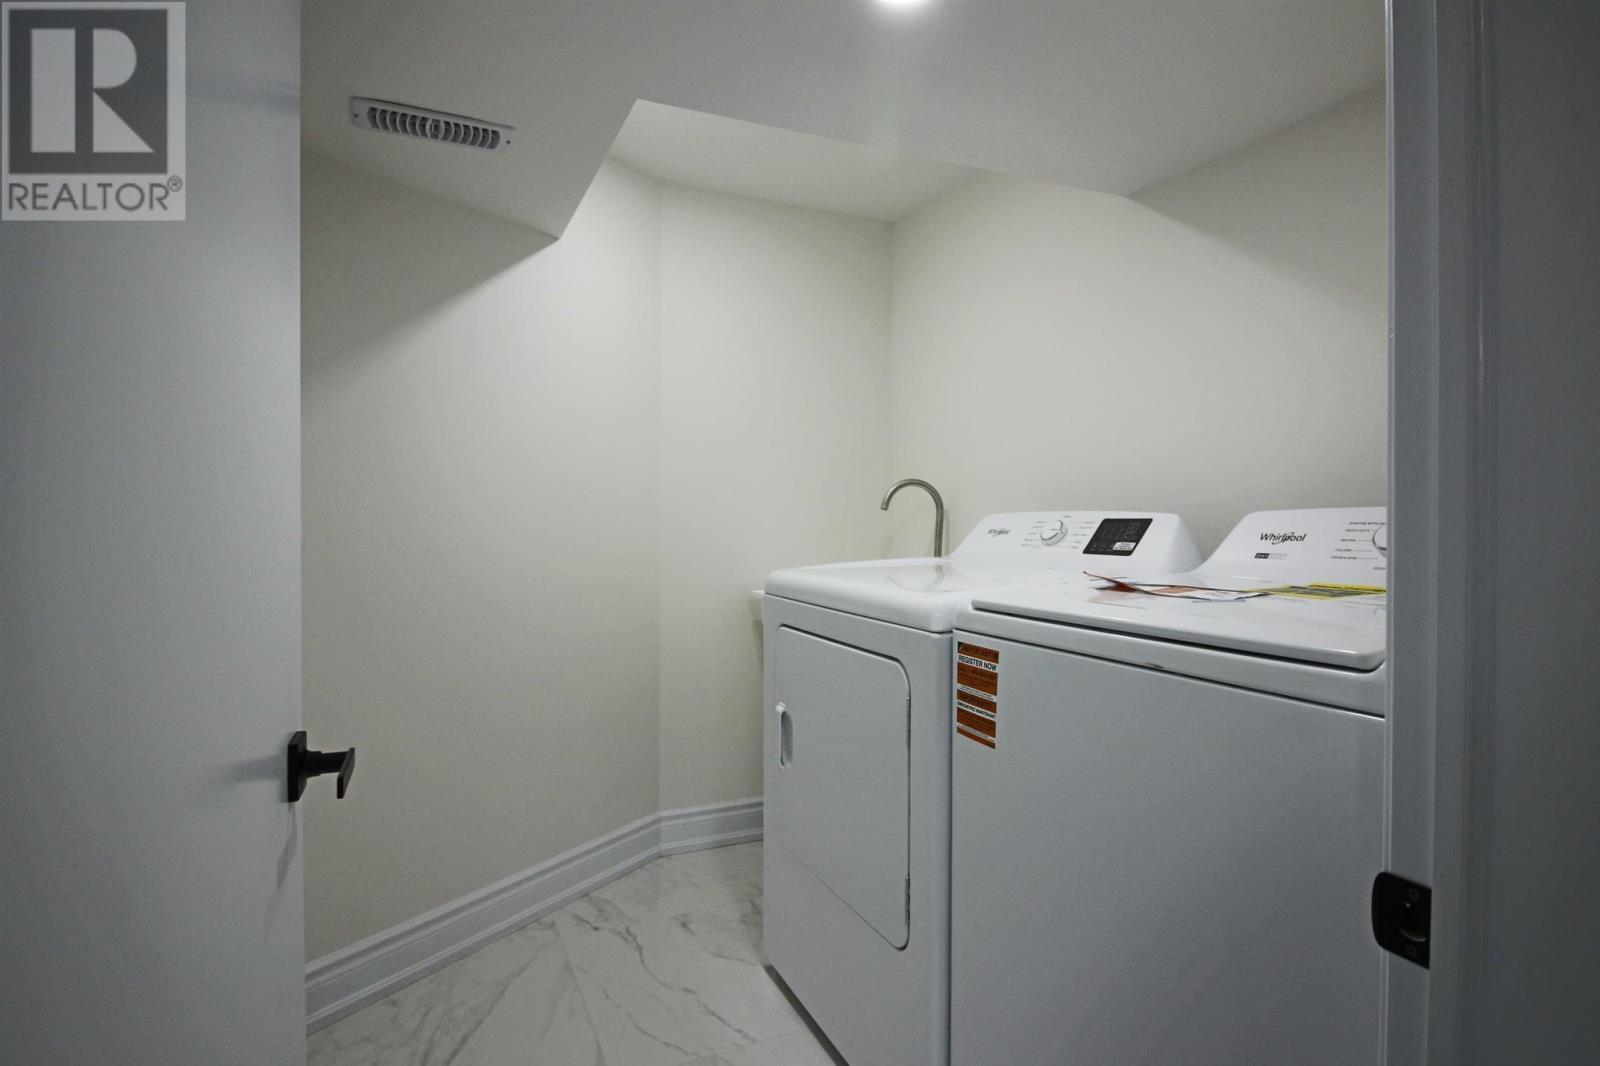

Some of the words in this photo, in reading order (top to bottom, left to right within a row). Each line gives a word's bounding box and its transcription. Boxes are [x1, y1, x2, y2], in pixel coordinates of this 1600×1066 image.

[1260, 532, 1307, 545] Whirlpool
[958, 655, 983, 668] REGISTER
[983, 662, 997, 672] NOW
